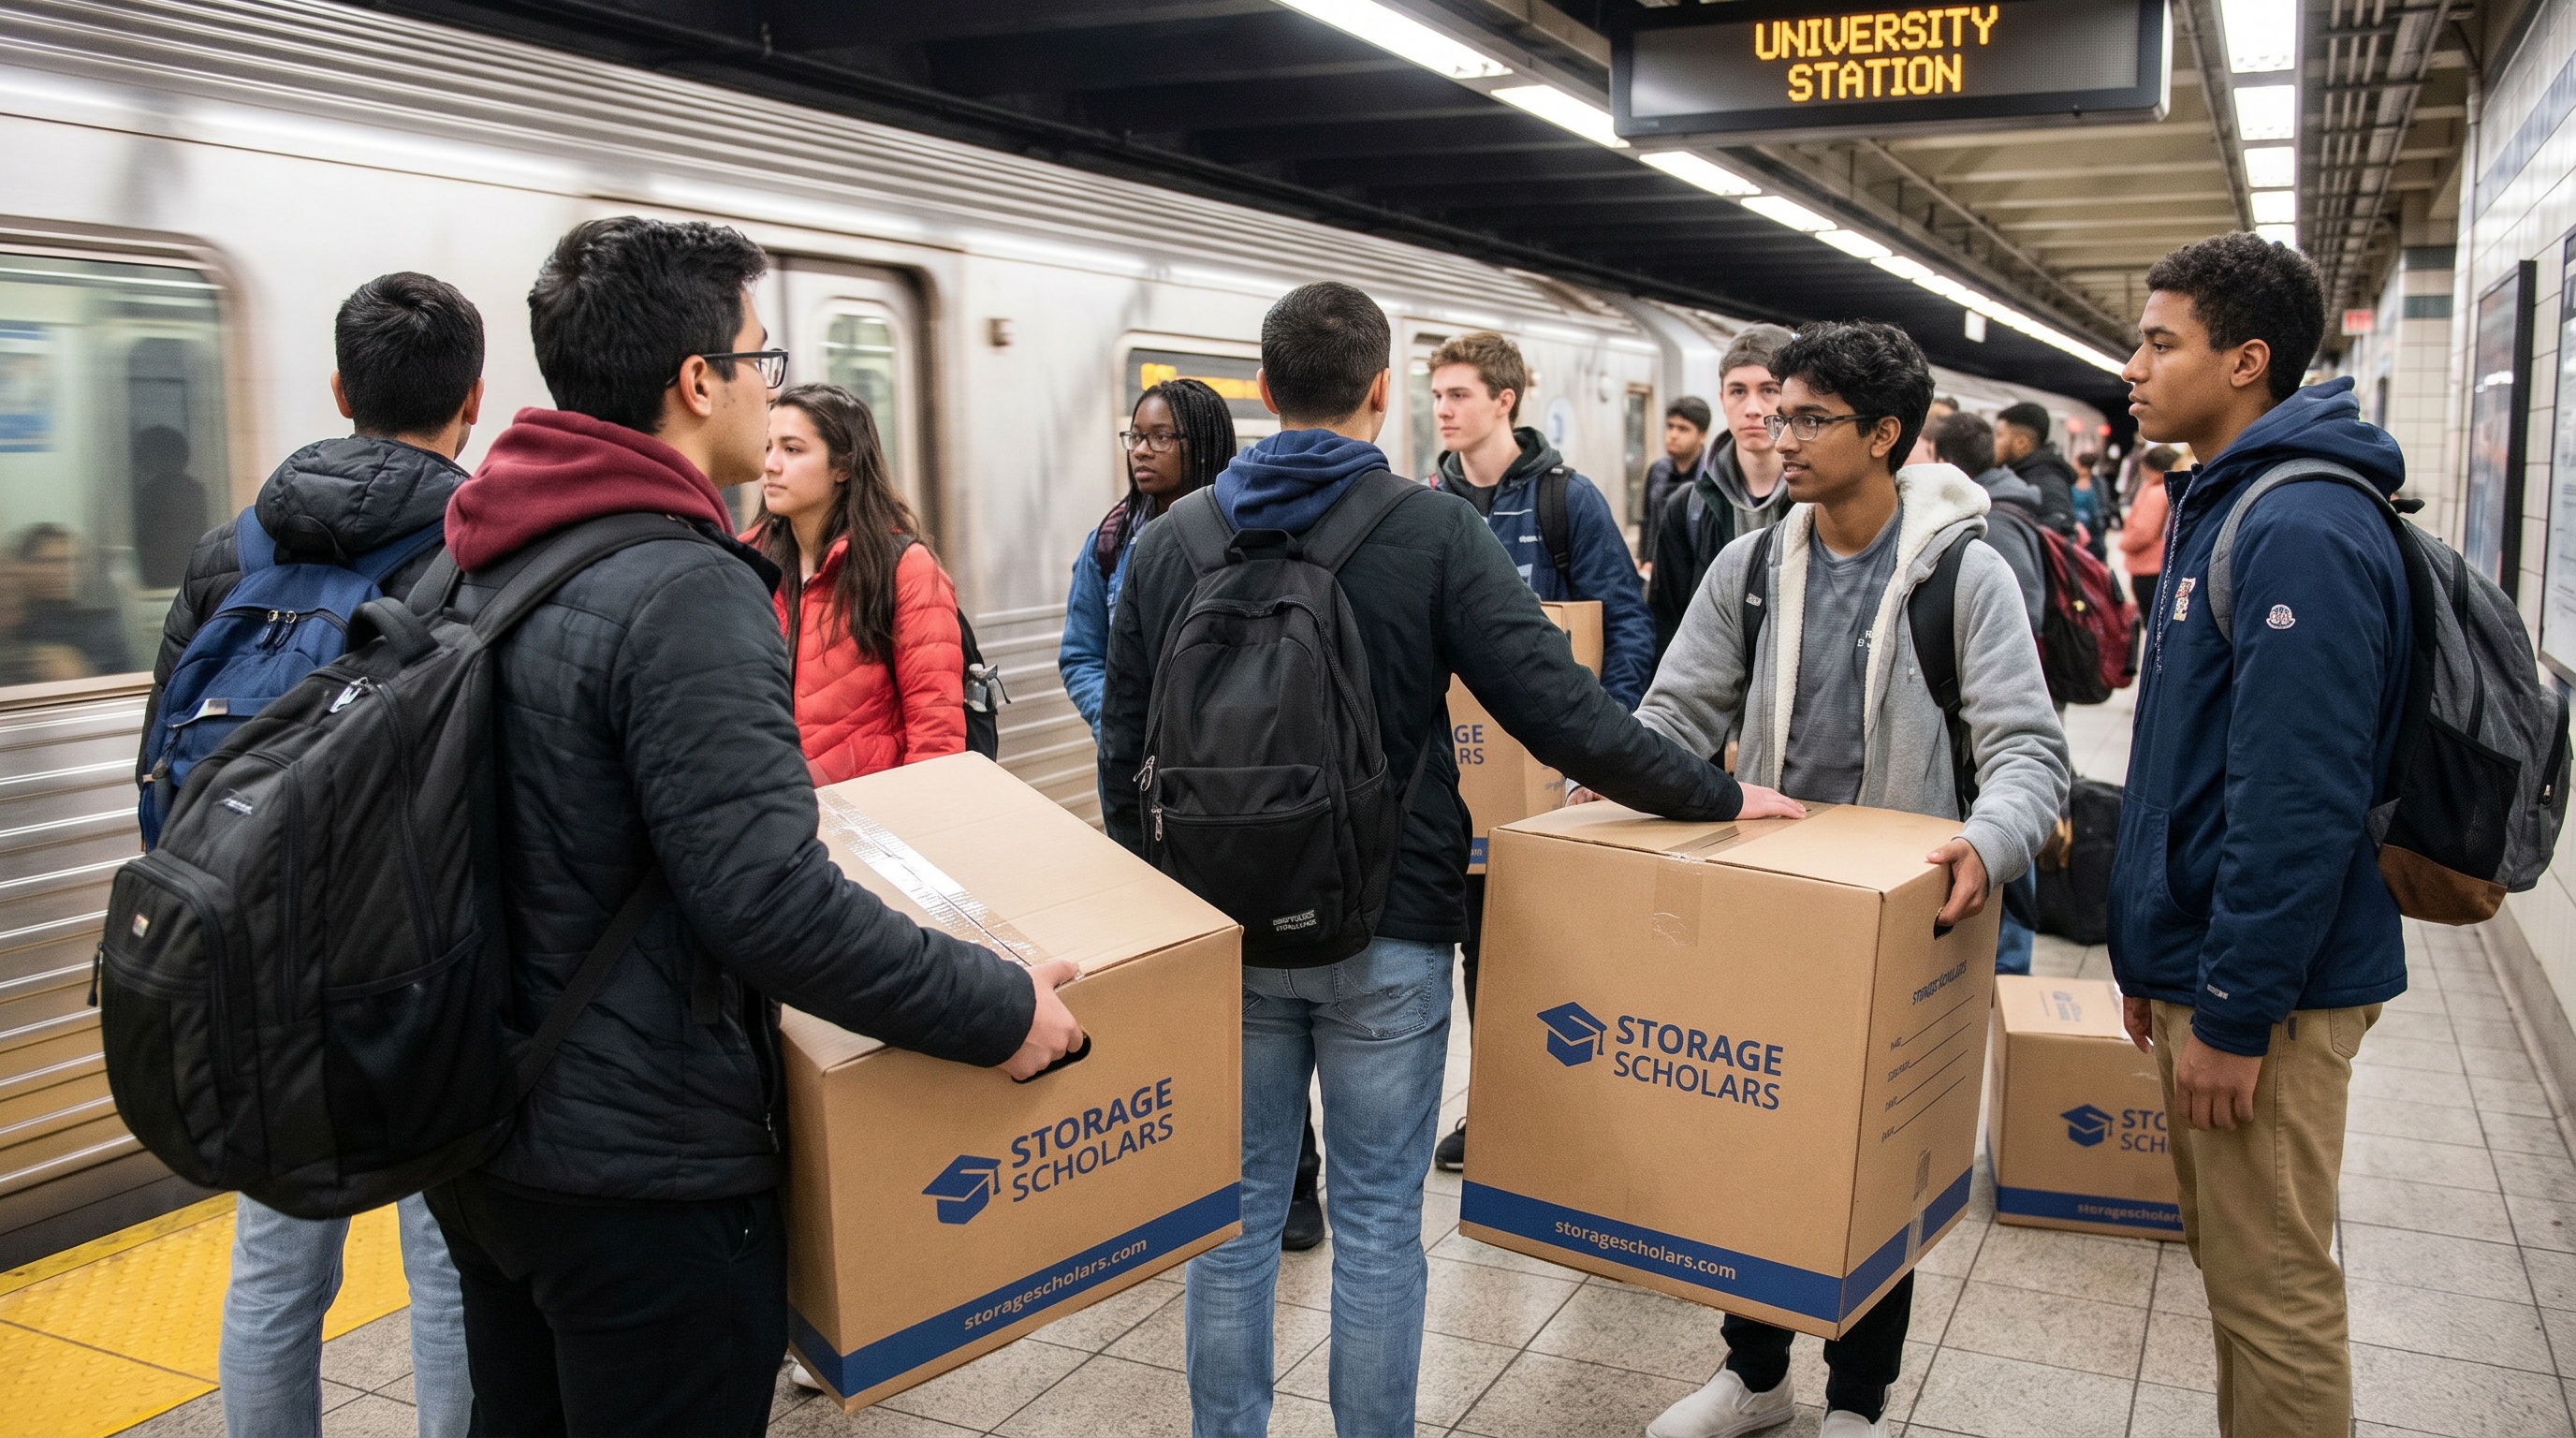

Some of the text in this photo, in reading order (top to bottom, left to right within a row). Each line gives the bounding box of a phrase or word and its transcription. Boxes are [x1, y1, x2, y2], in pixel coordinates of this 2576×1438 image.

[1755, 5, 1998, 60] UNIVERSITY
[1788, 53, 1962, 102] STATION
[1454, 725, 1485, 744] GE
[1459, 747, 1485, 766] RS
[1616, 1015, 1784, 1077] STORAGE
[1614, 1050, 1780, 1110] SCHOLARS
[1011, 1077, 1173, 1168] STORAGE
[2120, 1132, 2167, 1153] SCH
[2121, 1108, 2167, 1132] STO
[1012, 1113, 1174, 1202] SCHOLARS
[1555, 1221, 1736, 1280] storagescholars.com
[964, 1239, 1147, 1330] storagescholars.com
